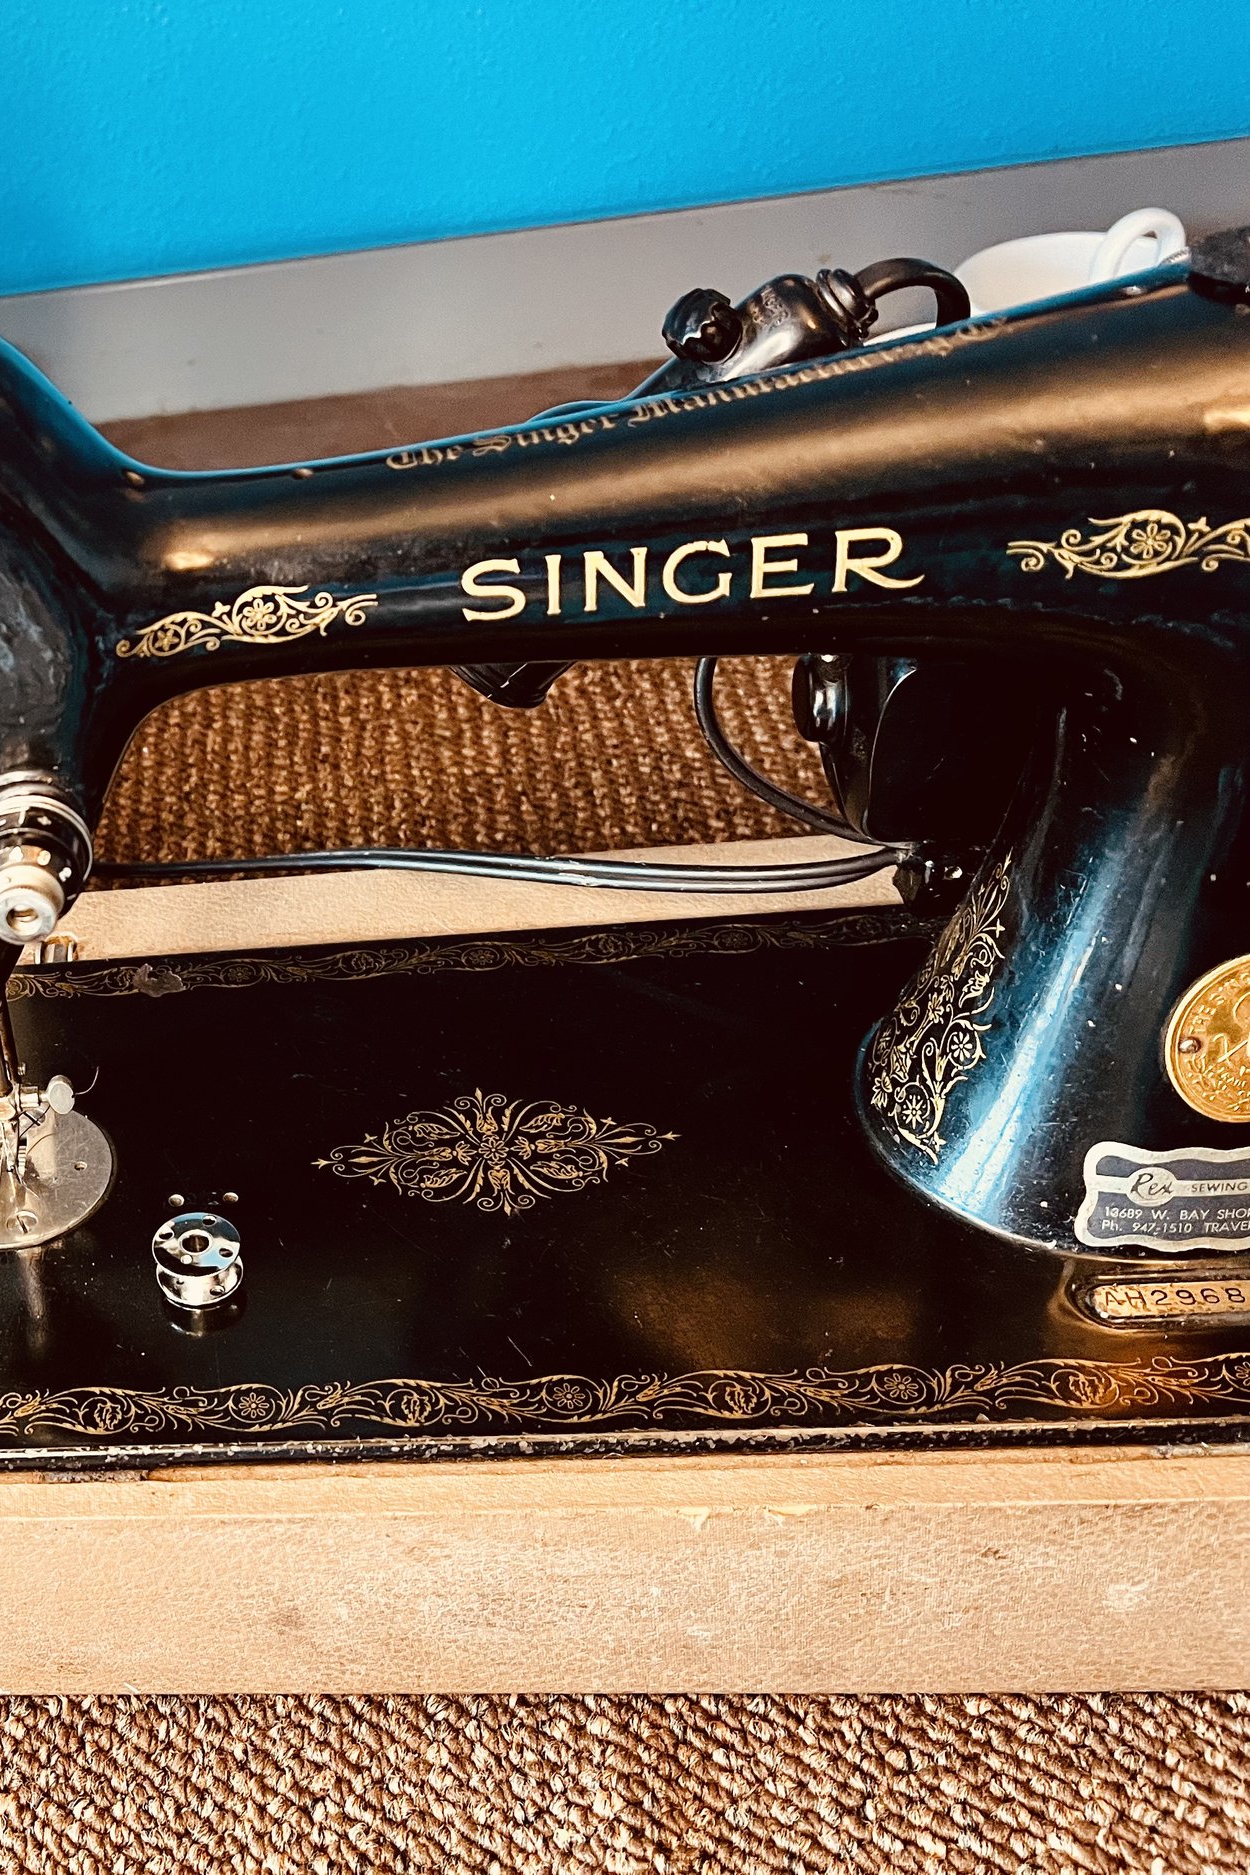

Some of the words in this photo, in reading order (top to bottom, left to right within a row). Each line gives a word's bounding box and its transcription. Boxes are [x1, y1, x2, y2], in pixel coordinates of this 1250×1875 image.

[460, 527, 926, 622] SINGER
[1130, 1172, 1174, 1200] Rex
[1191, 1181, 1248, 1193] SEWING
[1151, 1209, 1170, 1220] W.
[1179, 1209, 1210, 1220] BAY
[1101, 1219, 1123, 1232] Ph.
[1131, 1222, 1193, 1233] 947-1510
[1204, 1220, 1250, 1233] TRAVE
